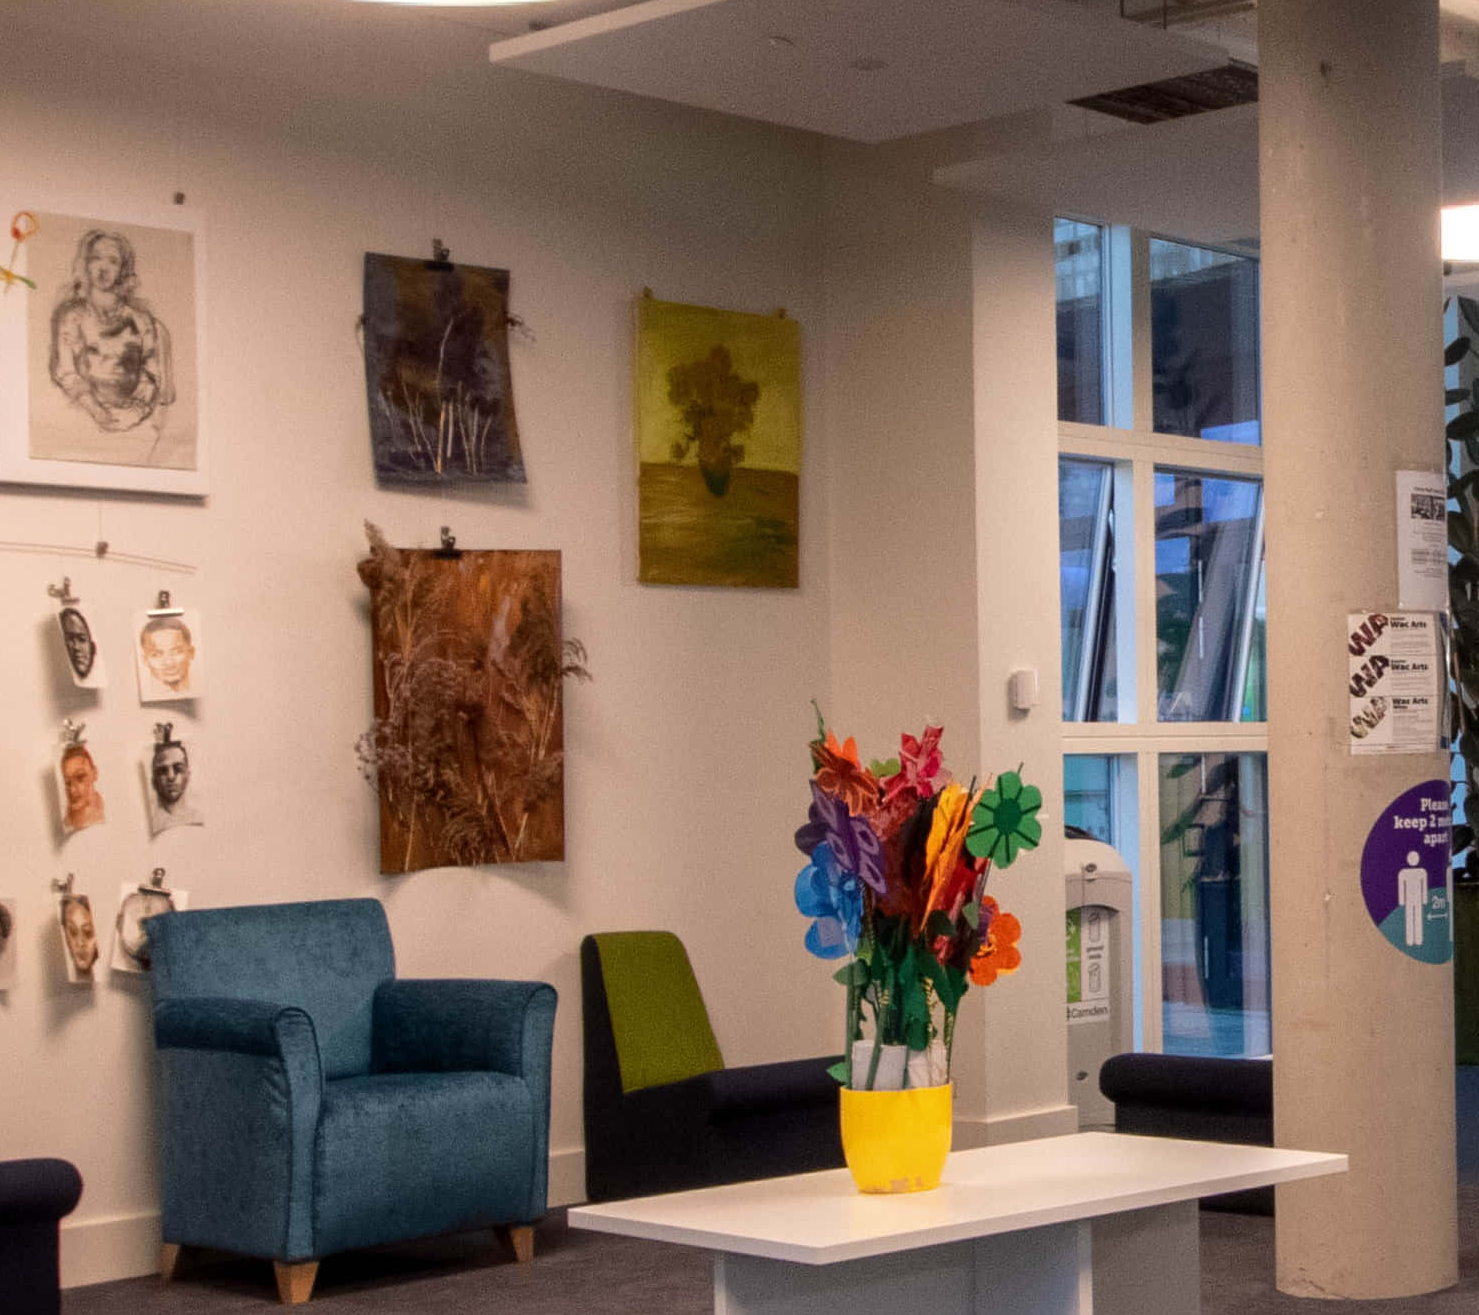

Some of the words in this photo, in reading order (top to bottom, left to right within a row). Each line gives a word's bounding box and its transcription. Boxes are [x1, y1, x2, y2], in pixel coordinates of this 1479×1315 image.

[1412, 620, 1427, 629] Arts
[1393, 815, 1428, 832] keep
[1429, 815, 1437, 828] 2
[1071, 1004, 1109, 1019] Camden
